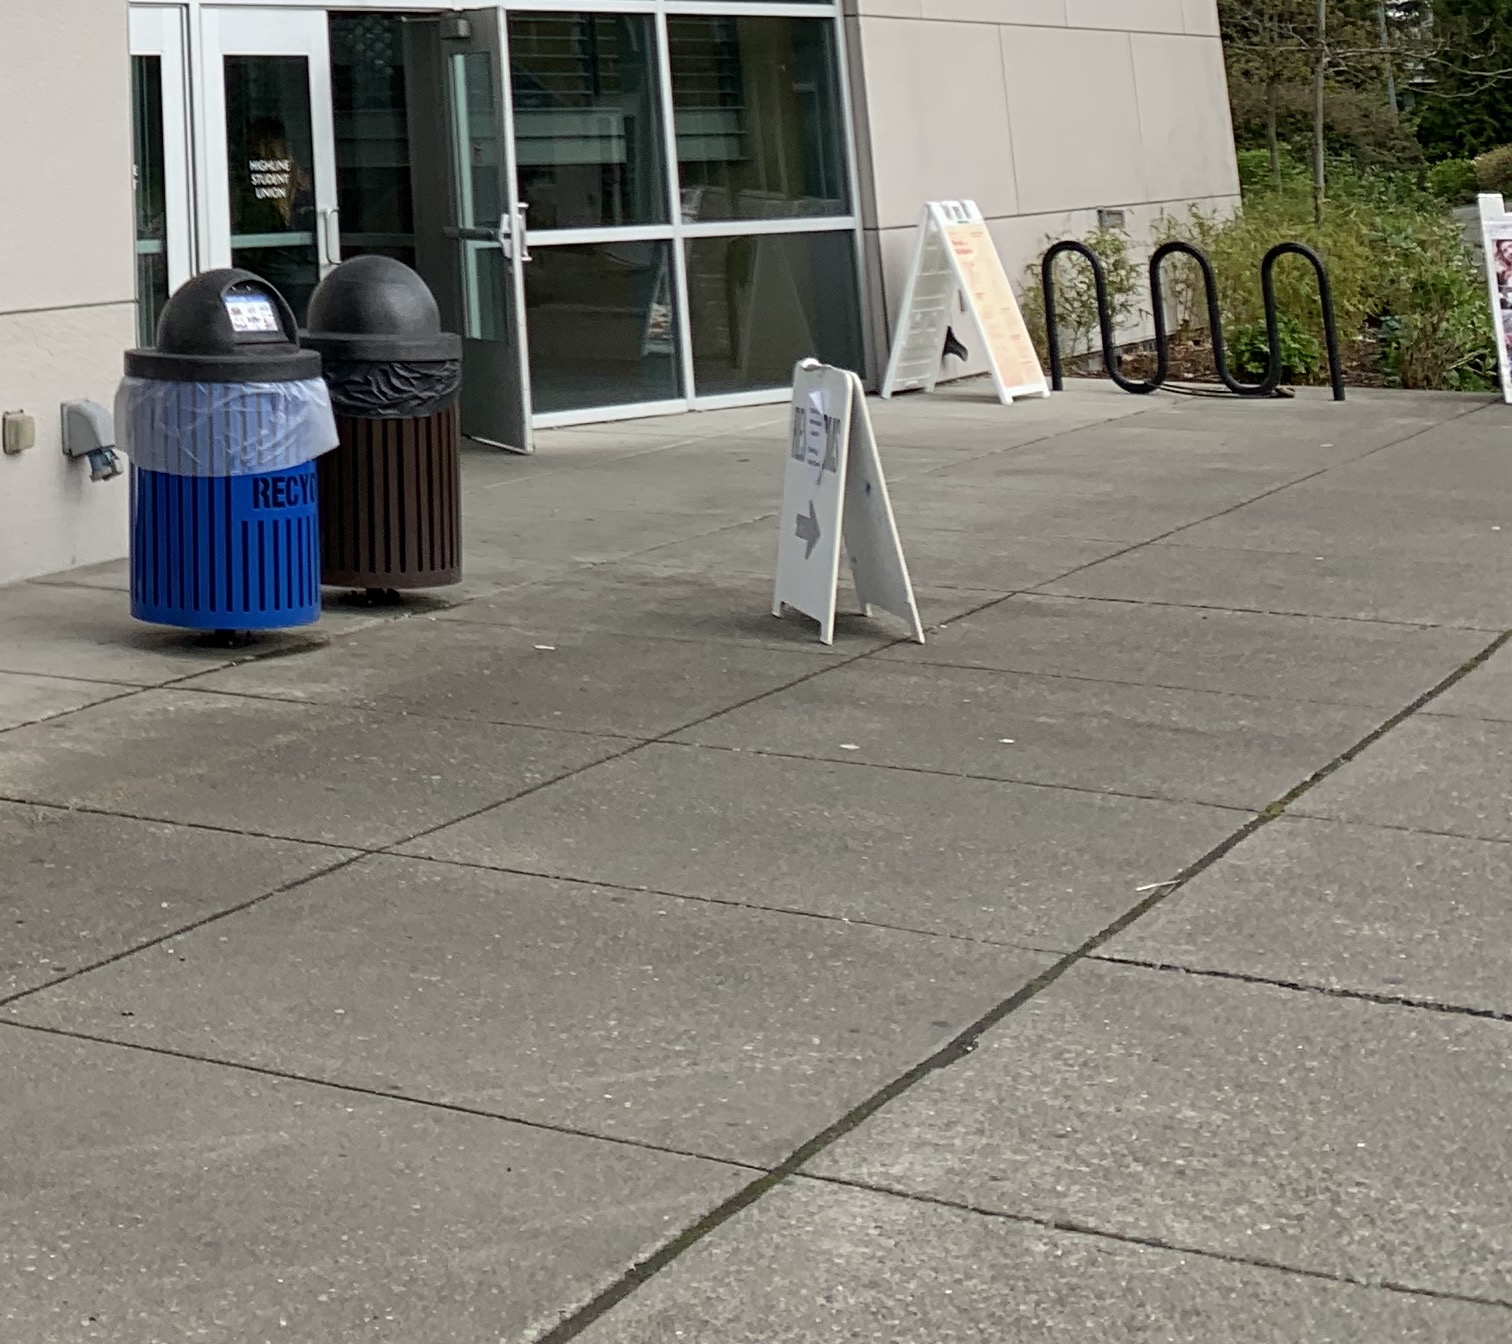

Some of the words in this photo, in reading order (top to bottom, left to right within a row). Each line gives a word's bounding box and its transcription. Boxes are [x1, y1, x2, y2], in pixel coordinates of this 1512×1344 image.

[249, 159, 290, 172] HIGHLINE
[250, 173, 290, 186] STUDENT
[255, 187, 286, 200] UNION
